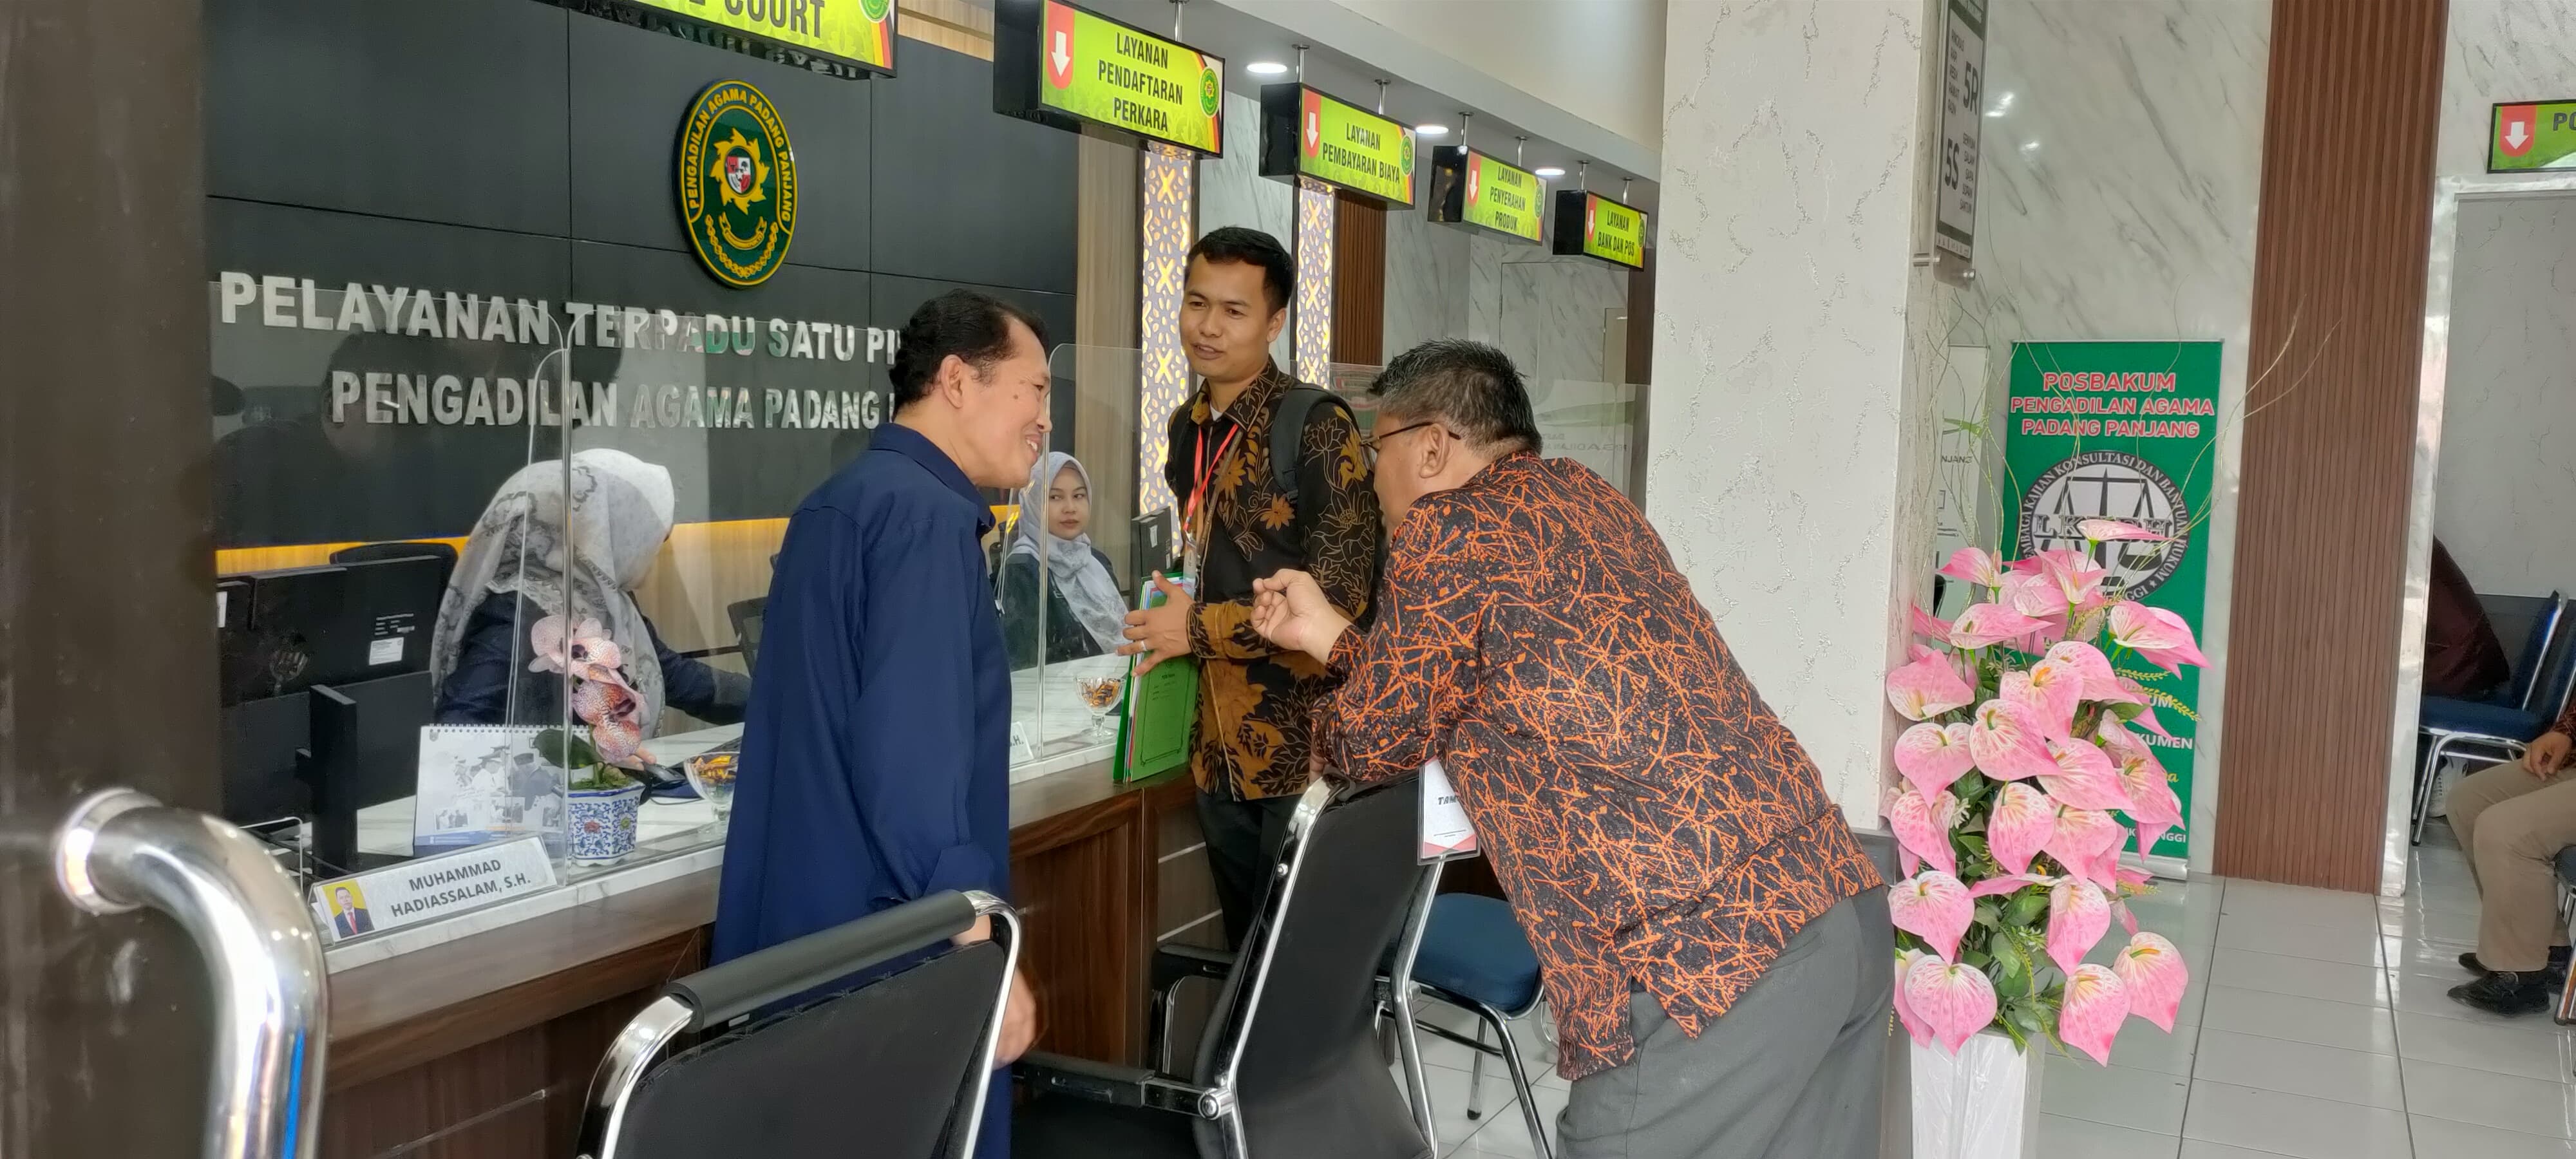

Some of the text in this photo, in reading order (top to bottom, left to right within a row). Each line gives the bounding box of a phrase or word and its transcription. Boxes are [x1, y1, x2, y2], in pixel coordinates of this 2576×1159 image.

[1116, 32, 1168, 69] LAYANAN
[1098, 59, 1183, 105] PENDAFTARAN
[1964, 61, 1979, 115] 5R
[1113, 97, 1168, 132] PERKARA
[1346, 122, 1381, 151] LAYANAN
[687, 88, 793, 223] PENGADILAN AGAMA PADANG PANJANG
[1322, 142, 1400, 184] PEMBAYARAN BIAYA
[1945, 138, 1960, 191] 5S
[1497, 166, 1522, 188] LAYANAN
[1490, 186, 1526, 211] PENYERAHAN
[1495, 211, 1518, 231] PRODUK
[1607, 210, 1630, 232] LAYANAN
[1598, 231, 1613, 249] BANK
[1613, 236, 1624, 253] DAN
[220, 270, 901, 365] PELAYANAN TERPADU SATU PI
[2043, 372, 2176, 392] POSBAKUM
[332, 370, 618, 427] PENGADILAN
[630, 384, 755, 429] AGAMA
[764, 388, 881, 429] PADANG
[2011, 397, 2215, 416] PENGADILAN AGAMA
[2022, 419, 2200, 438] PADANG PANJANG
[1942, 455, 1973, 465] NJANG
[2023, 471, 2054, 509] KAJIAN
[2054, 452, 2136, 475] KONSULTASI
[2135, 460, 2164, 482] DAN
[408, 859, 502, 891] MUHAMMAD
[390, 872, 531, 918] HADIASSALAM, S.H.
